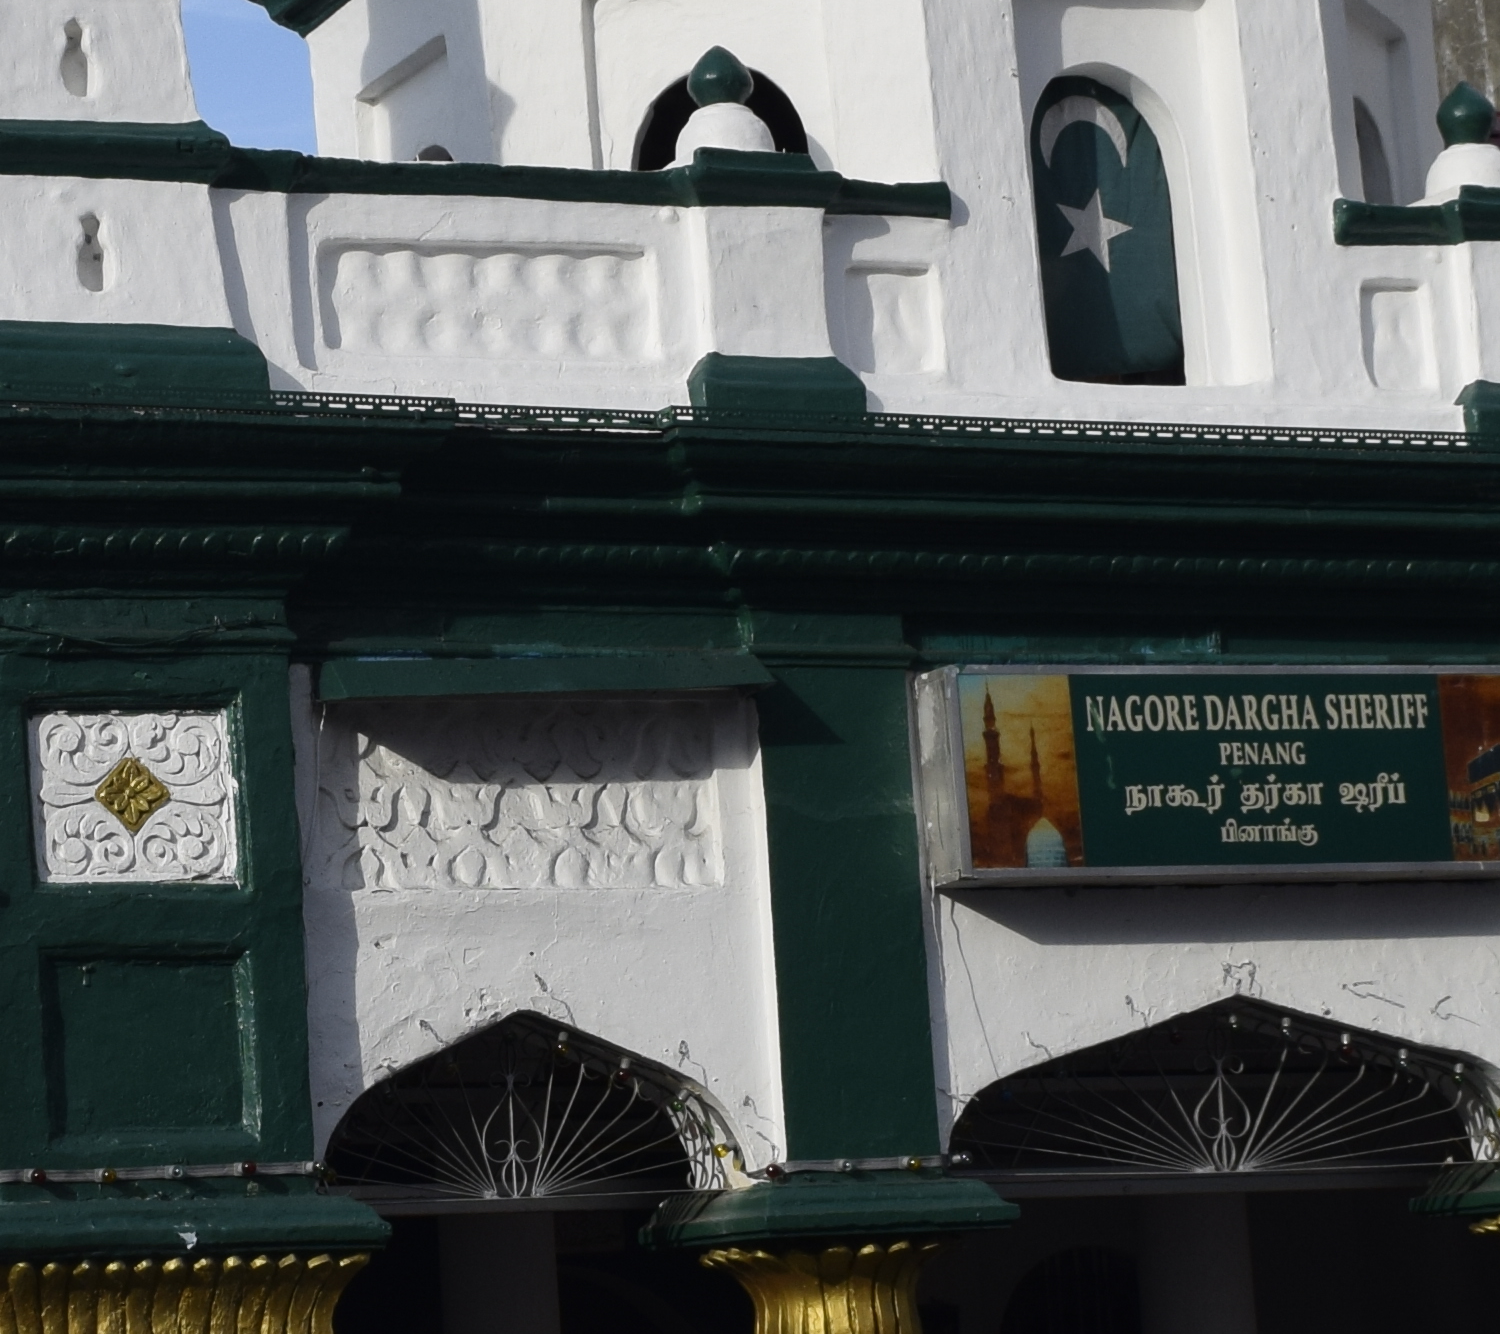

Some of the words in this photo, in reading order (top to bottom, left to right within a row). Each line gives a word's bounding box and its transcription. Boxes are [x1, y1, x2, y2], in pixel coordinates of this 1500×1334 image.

[1086, 695, 1200, 731] NAGORE
[1203, 694, 1320, 731] DARGHA
[1324, 693, 1429, 729] SHERIFF
[1218, 741, 1307, 765] PENANG
